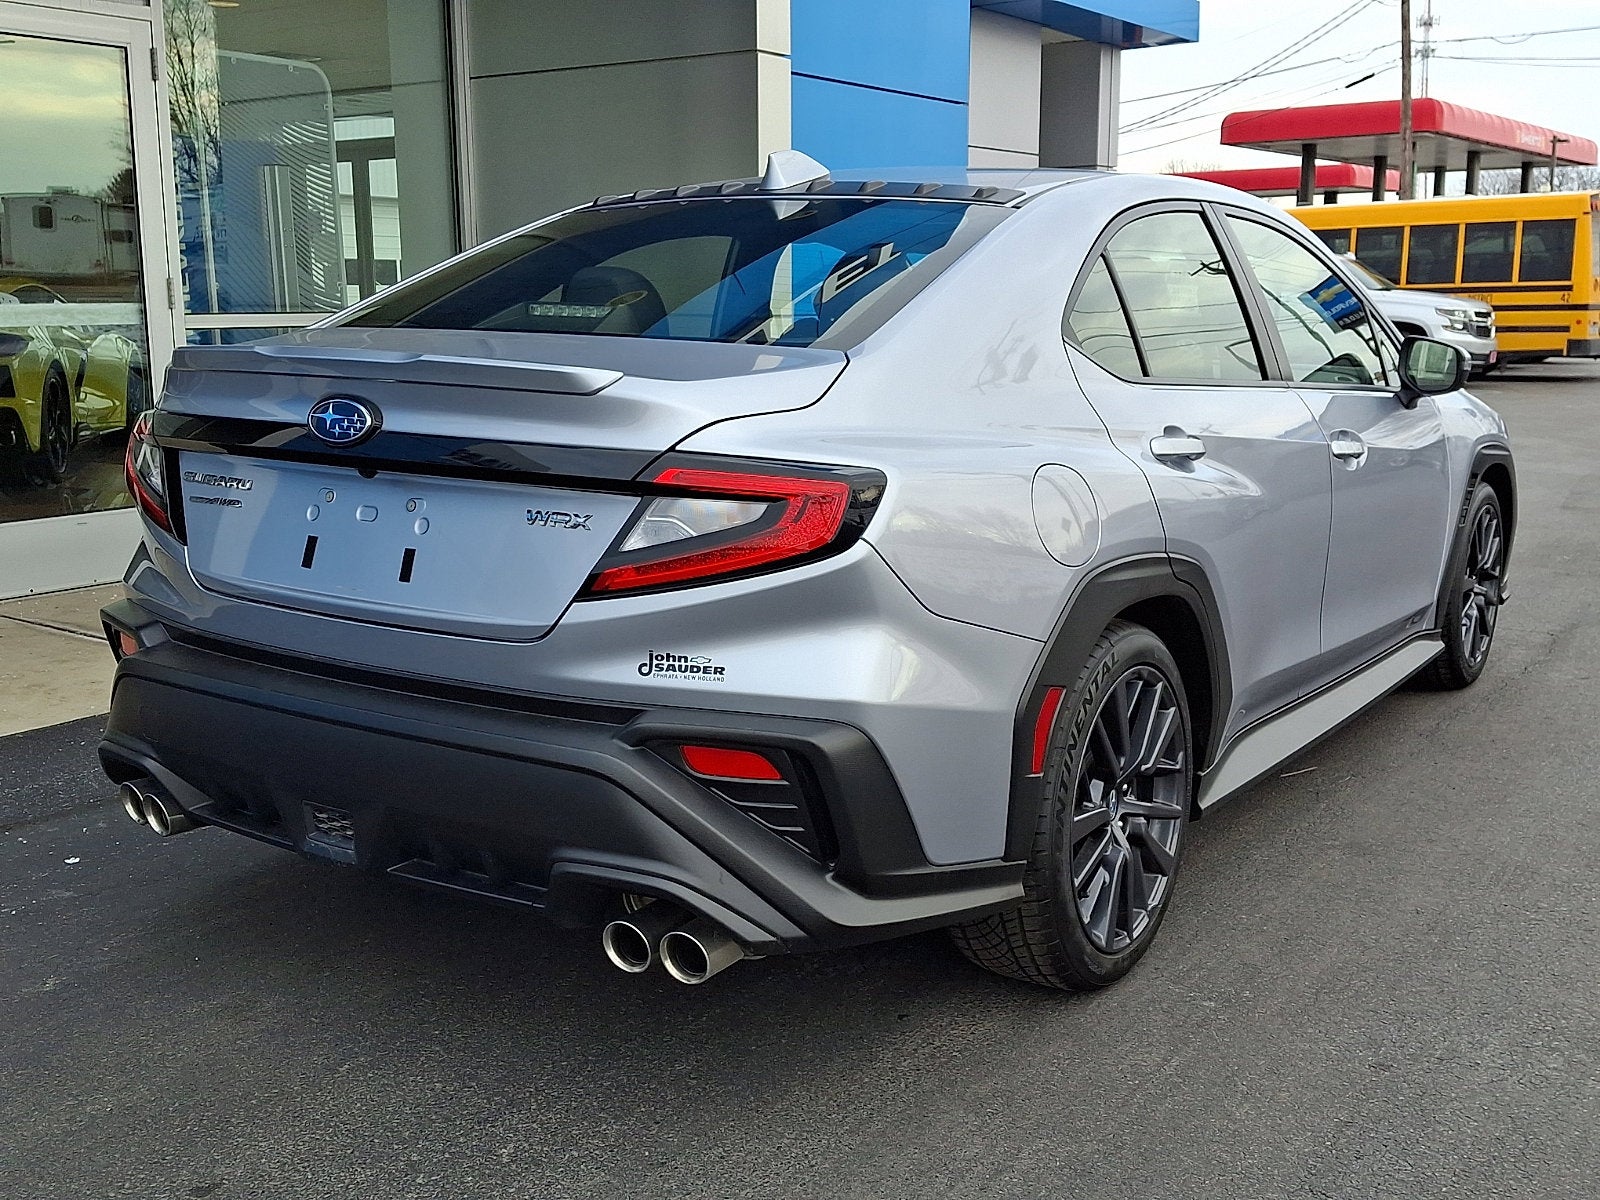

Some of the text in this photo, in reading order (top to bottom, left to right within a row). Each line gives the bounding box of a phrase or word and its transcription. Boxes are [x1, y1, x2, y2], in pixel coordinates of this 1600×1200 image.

[1560, 293, 1571, 303] 42
[183, 471, 253, 491] SUBARU
[526, 508, 593, 531] WRX
[637, 649, 689, 677] john
[654, 663, 726, 676] SAUDER
[698, 675, 725, 683] HOLLAND
